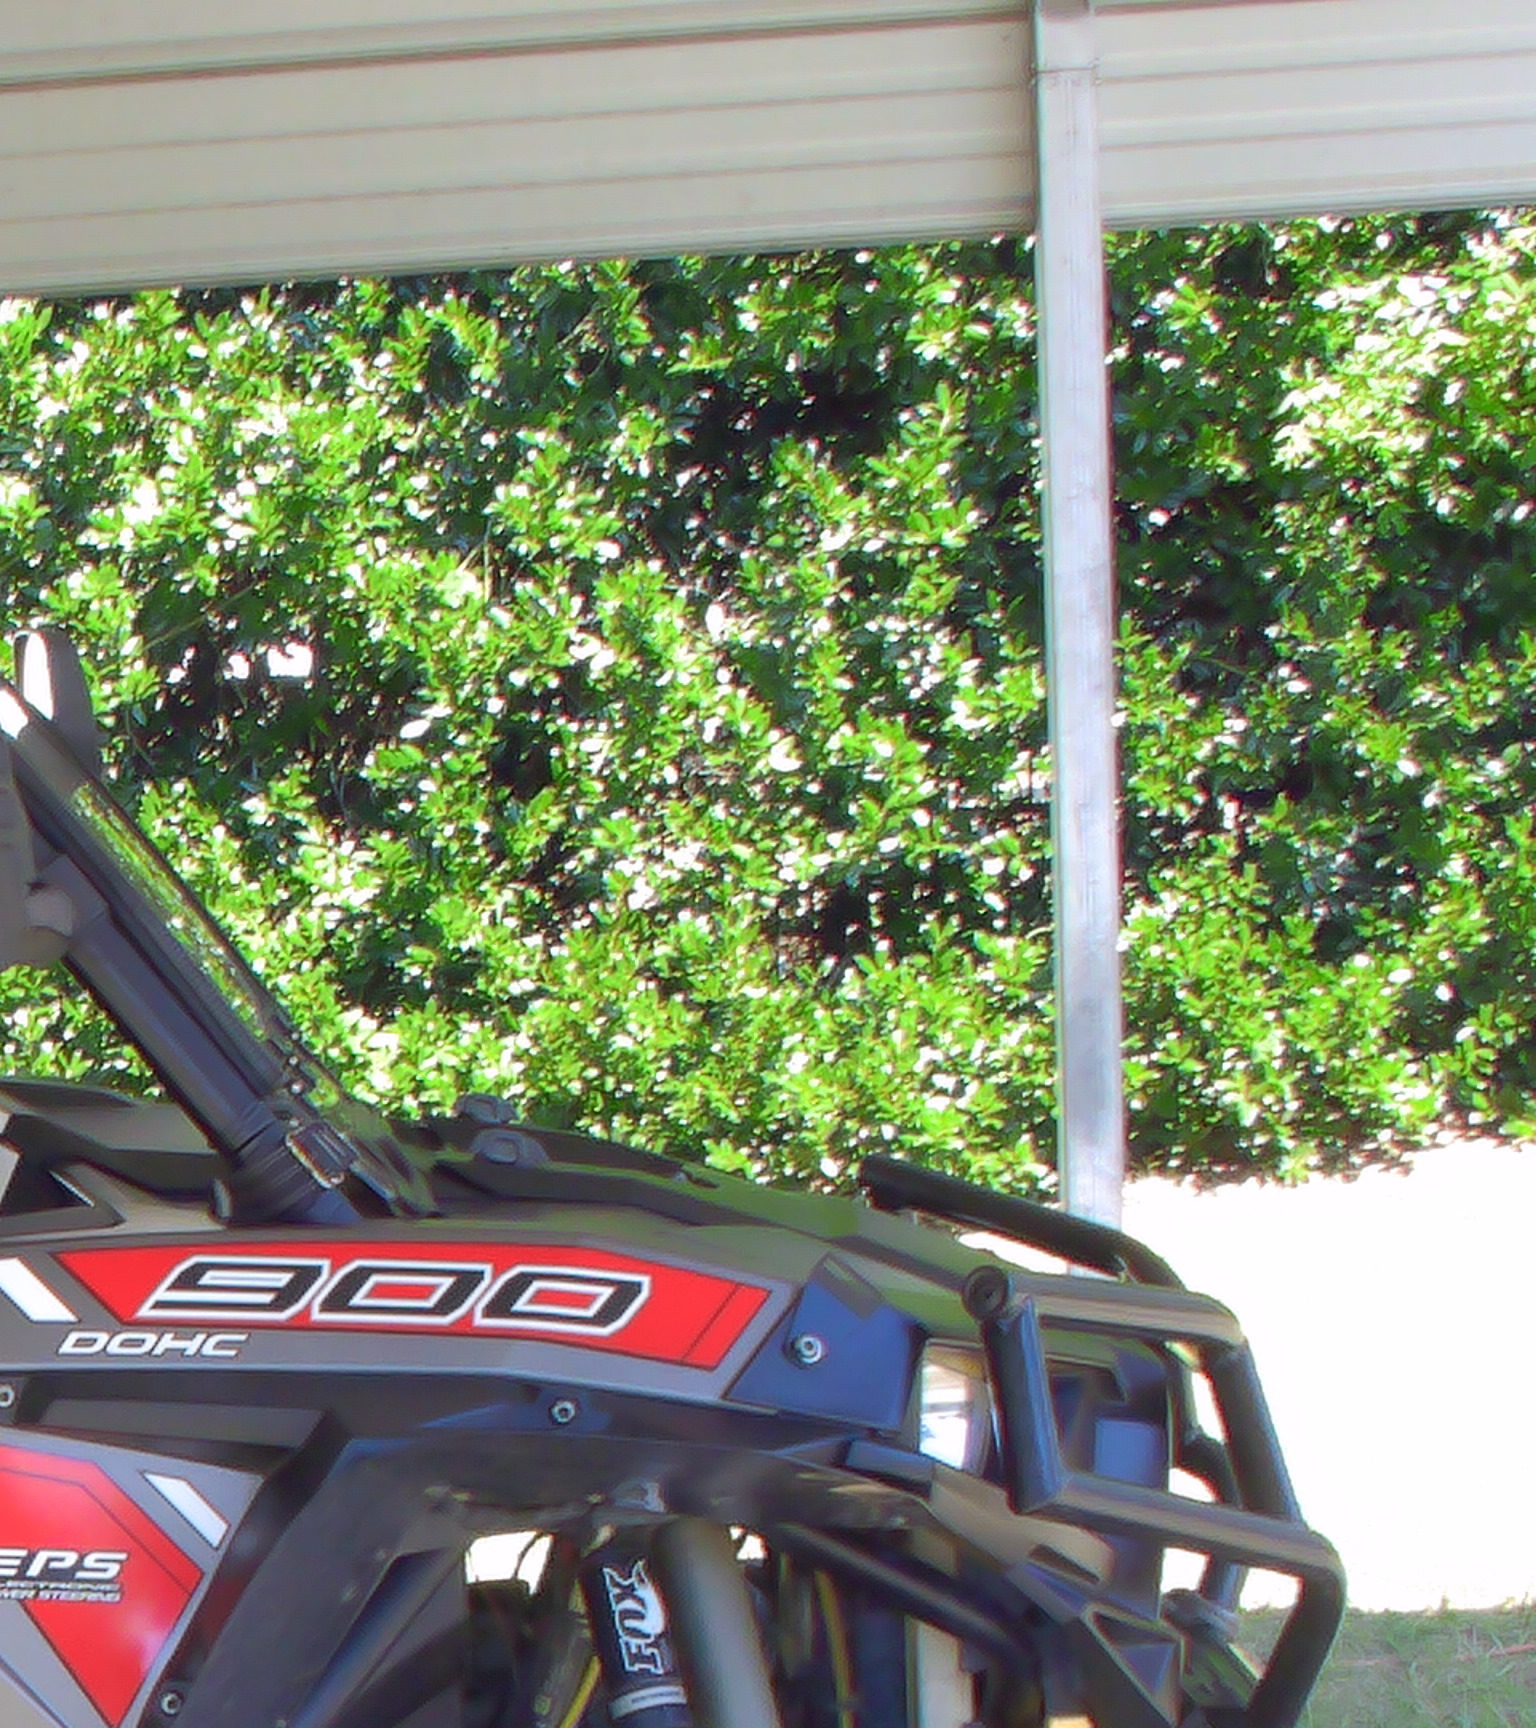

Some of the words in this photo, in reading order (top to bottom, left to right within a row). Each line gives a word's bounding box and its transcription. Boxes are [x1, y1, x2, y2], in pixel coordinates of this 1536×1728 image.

[133, 1254, 651, 1336] 900
[56, 1332, 250, 1357] DOHC
[37, 1589, 121, 1603] STEERING
[602, 1559, 666, 1675] FOX
